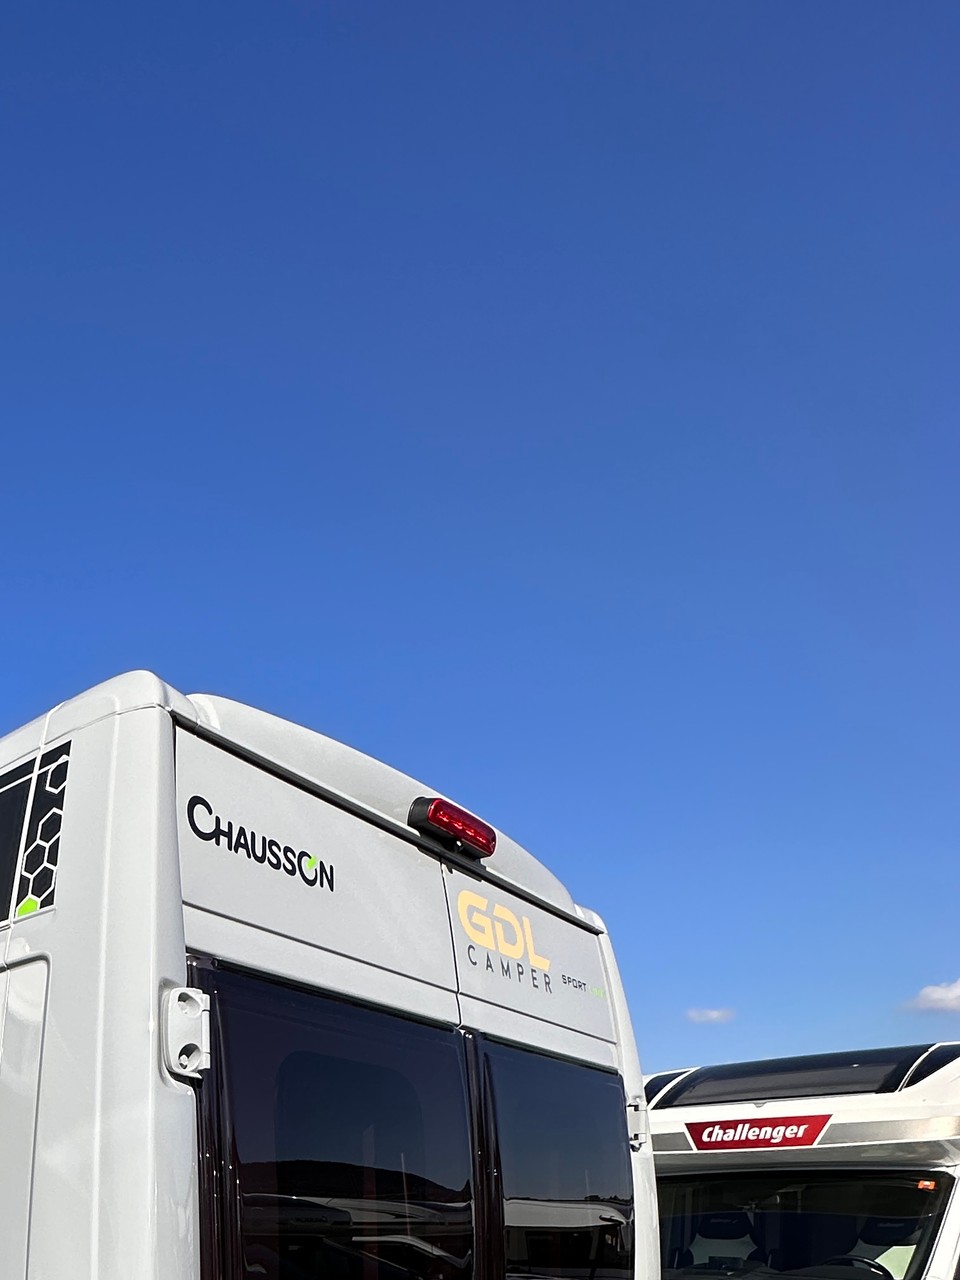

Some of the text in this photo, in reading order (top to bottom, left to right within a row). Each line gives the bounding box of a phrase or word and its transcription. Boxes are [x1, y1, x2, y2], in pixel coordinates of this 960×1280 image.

[187, 795, 334, 892] CHAUSSON
[457, 890, 551, 972] GDL
[467, 944, 552, 994] CAMPER
[561, 974, 587, 992] SPORT
[701, 1123, 809, 1144] Challenger
